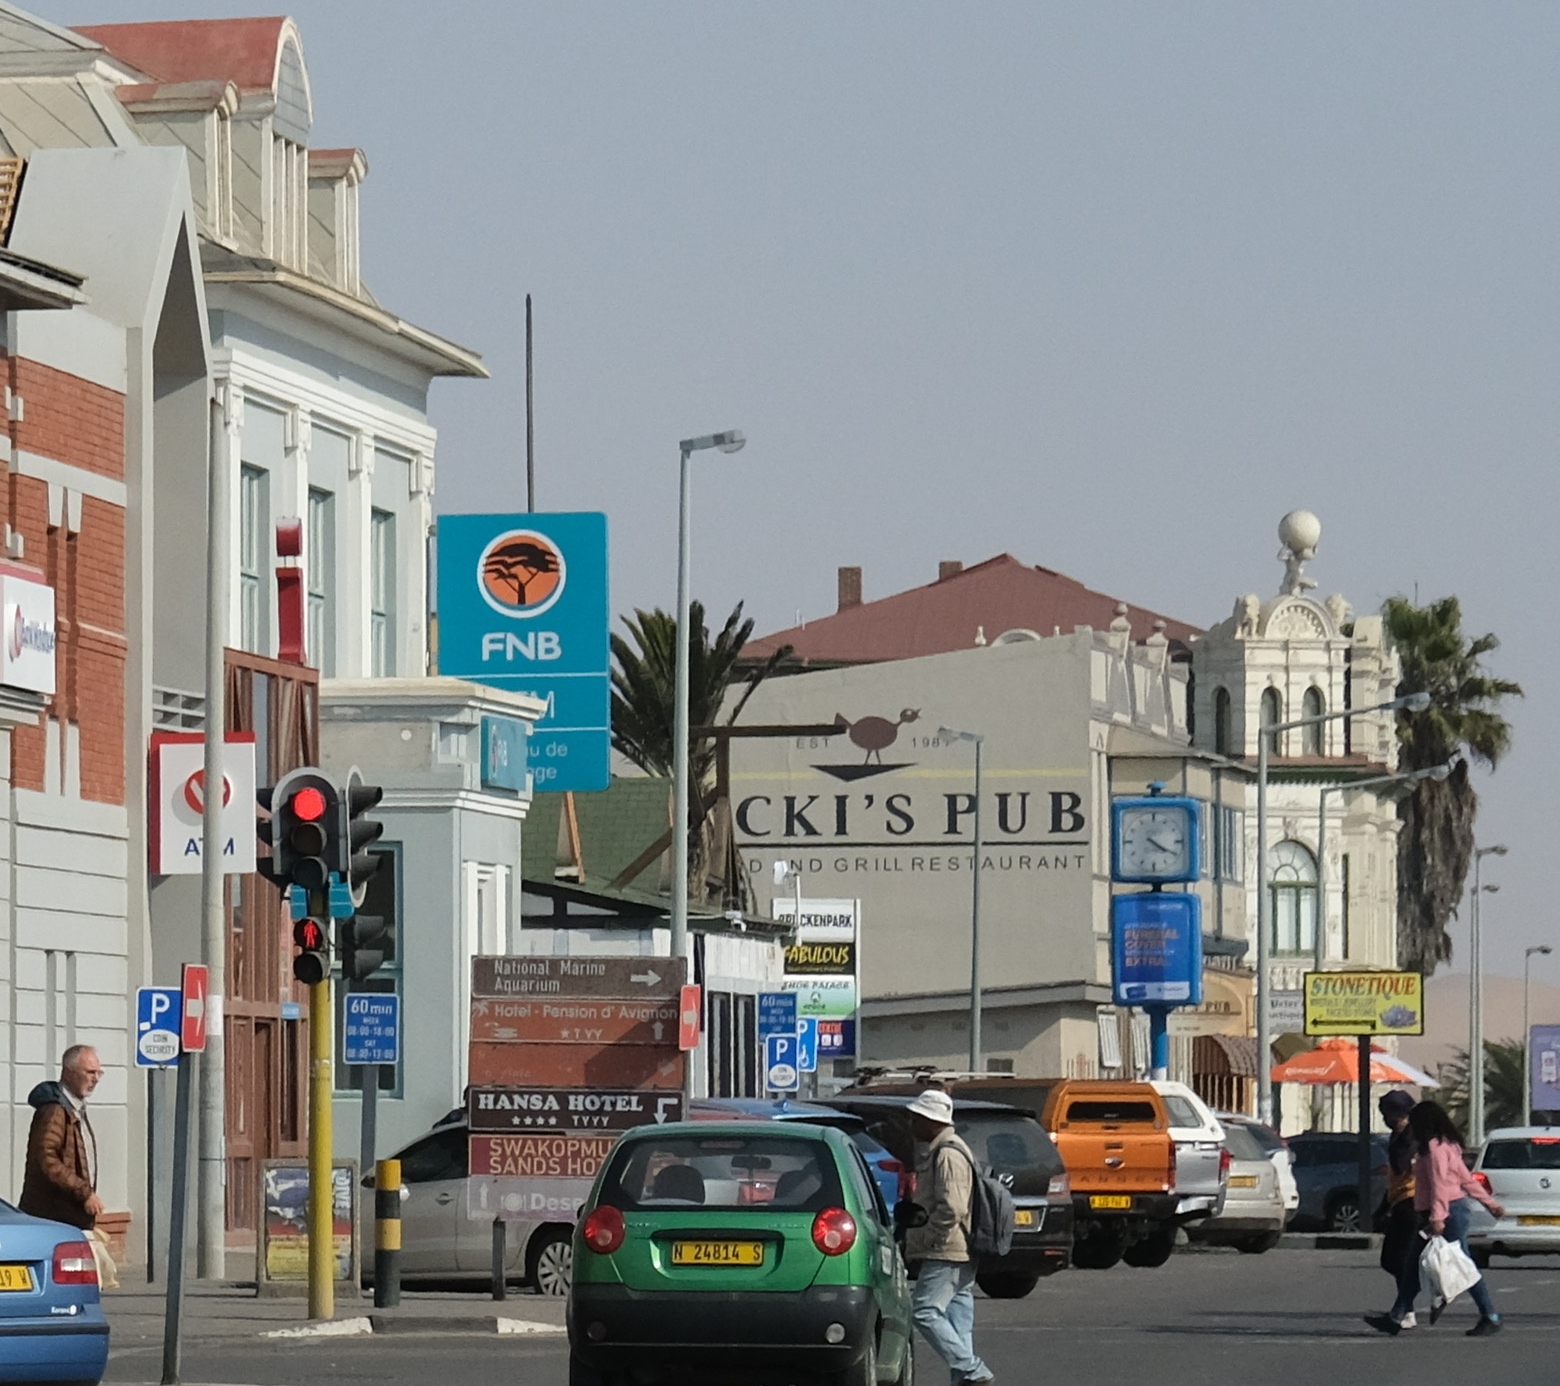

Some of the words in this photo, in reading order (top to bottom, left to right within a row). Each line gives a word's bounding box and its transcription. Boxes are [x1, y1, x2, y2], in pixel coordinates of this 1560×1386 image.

[481, 631, 563, 662] FNB
[546, 741, 569, 758] de
[795, 737, 831, 750] EST
[942, 791, 1086, 836] PUB
[833, 856, 903, 872] GRILL
[911, 854, 1086, 872] RESTAURANT
[493, 959, 550, 976] National
[560, 959, 607, 976] Marine
[493, 977, 561, 995] Aquarium
[1310, 976, 1417, 997] STONETIQUE
[151, 992, 171, 1025] P
[351, 999, 369, 1014] 60
[494, 1004, 532, 1018] Hotel
[542, 1004, 599, 1019] Pension
[619, 1004, 679, 1022] Avignon
[776, 1038, 789, 1062] P
[477, 1093, 561, 1111] HANSA
[567, 1094, 644, 1112] HOTEL
[489, 1156, 562, 1176] SANDS
[674, 1244, 684, 1261] N
[693, 1243, 740, 1261] 24814
[752, 1243, 761, 1261] S
